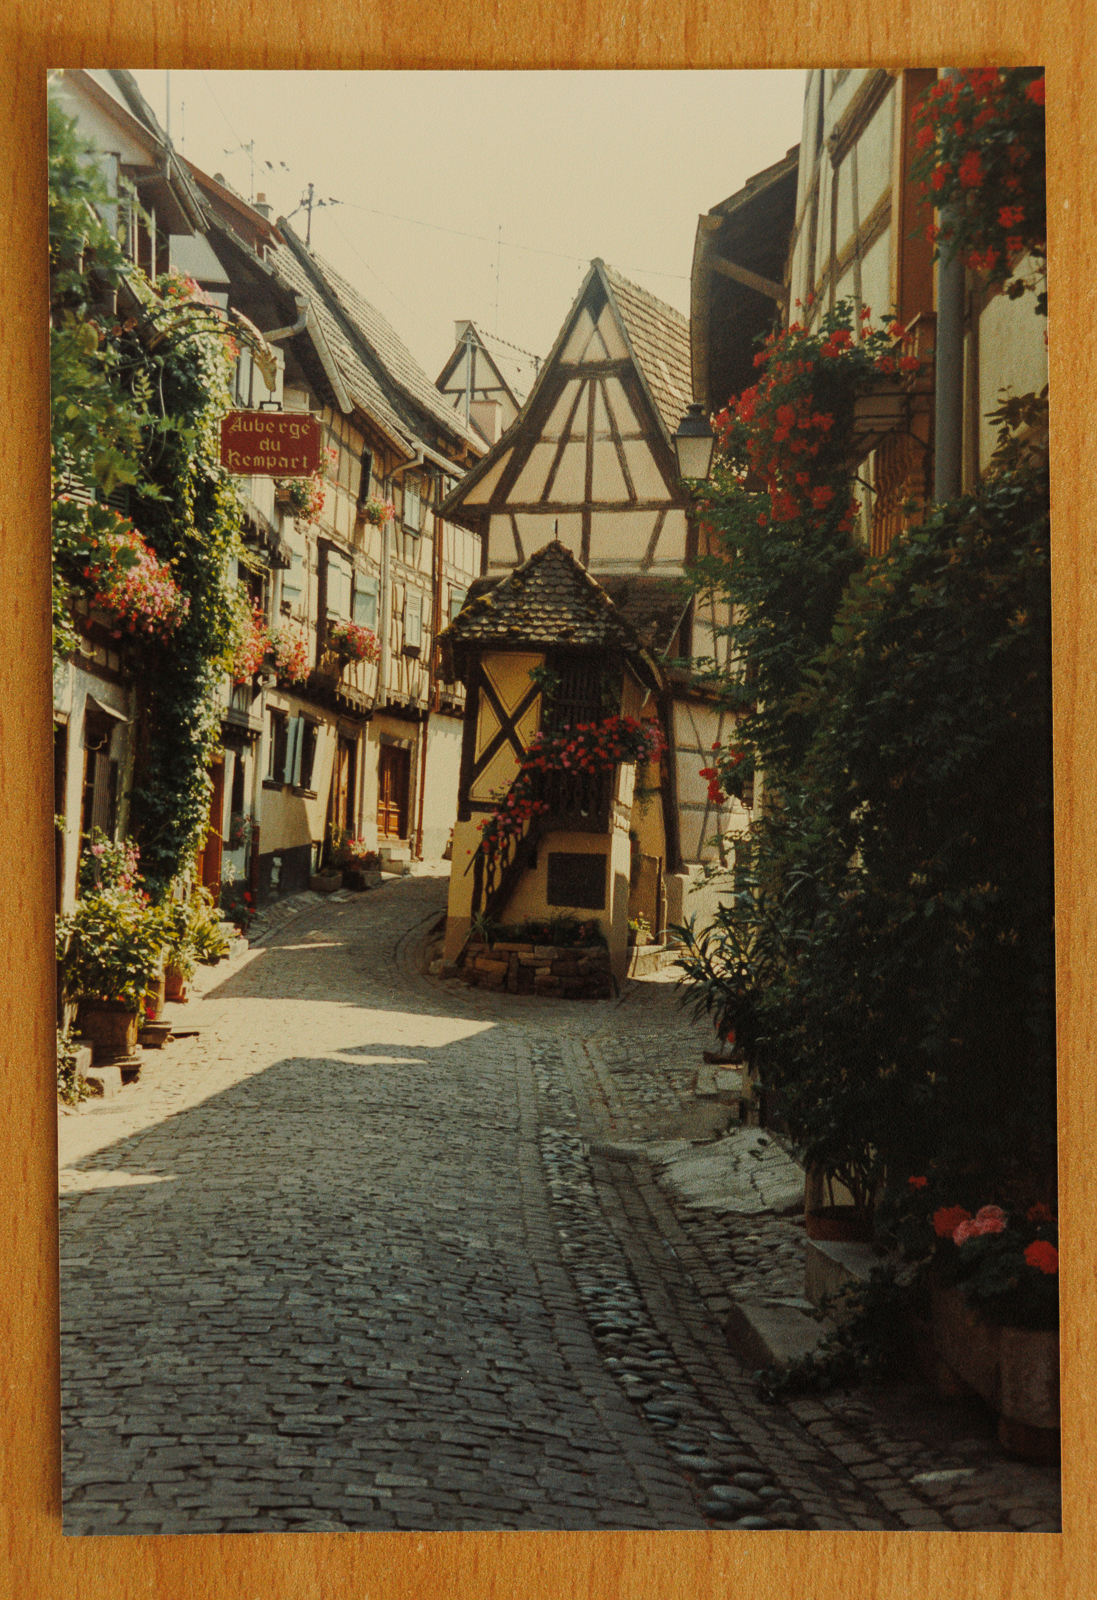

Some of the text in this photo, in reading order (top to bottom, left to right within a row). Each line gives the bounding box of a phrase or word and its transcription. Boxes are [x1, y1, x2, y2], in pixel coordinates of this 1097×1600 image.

[228, 417, 310, 439] Auberge
[259, 437, 281, 451] du
[226, 448, 308, 470] Rempart
